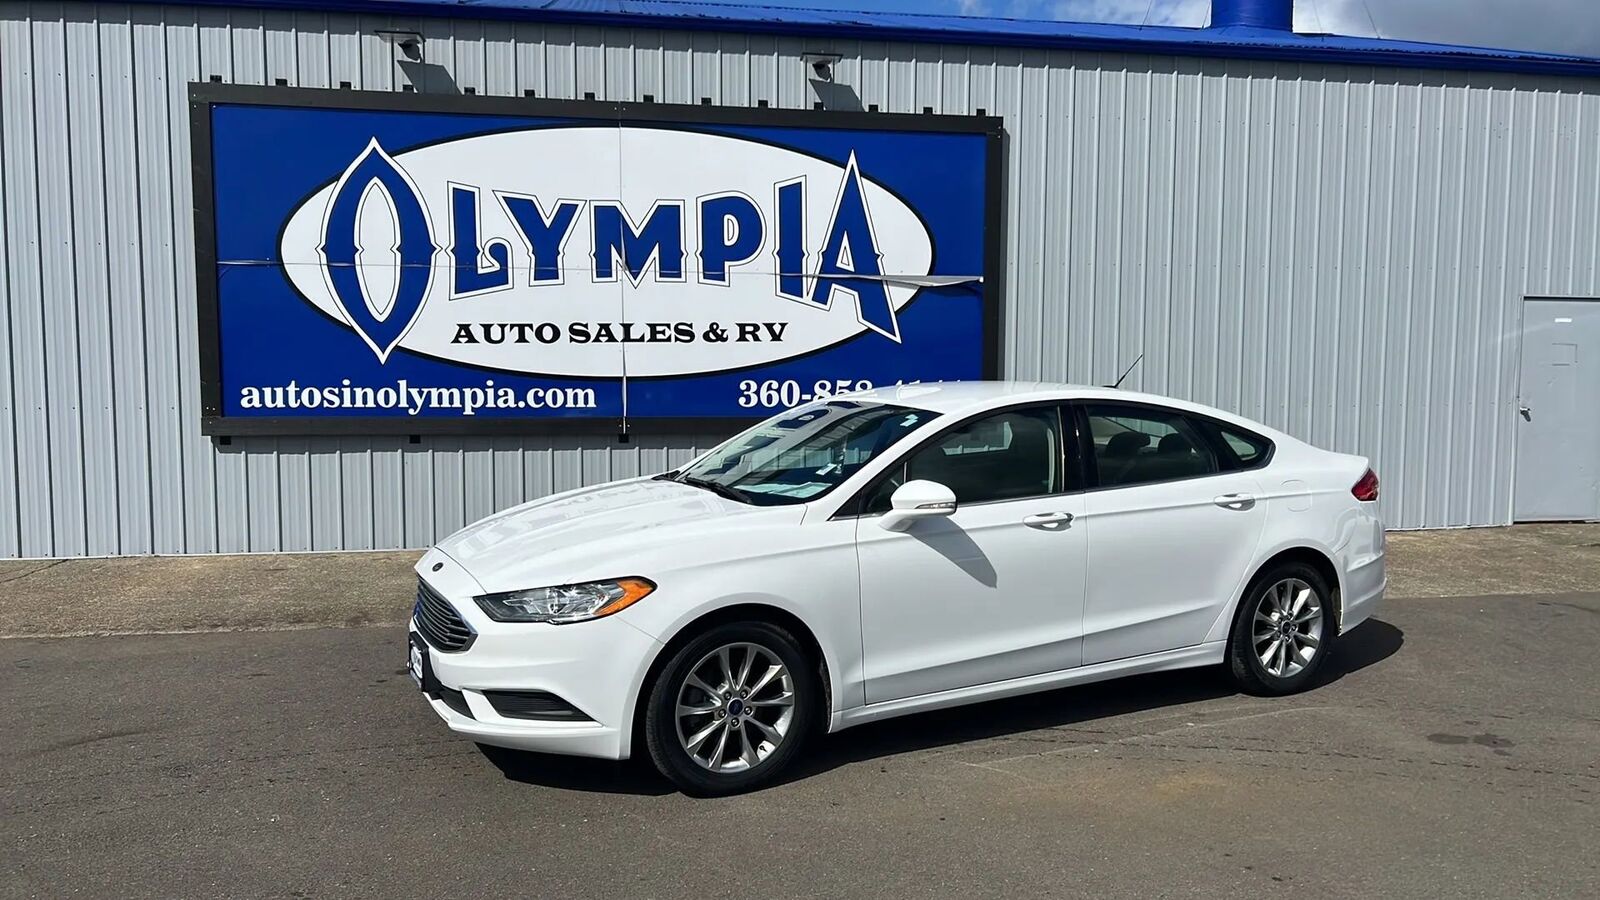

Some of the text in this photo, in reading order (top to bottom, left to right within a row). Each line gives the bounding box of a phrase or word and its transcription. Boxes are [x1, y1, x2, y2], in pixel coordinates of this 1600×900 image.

[315, 136, 902, 365] OLYMPIA
[451, 322, 788, 344] AUTO SALES & RV
[240, 379, 597, 416] autosinolympia.com
